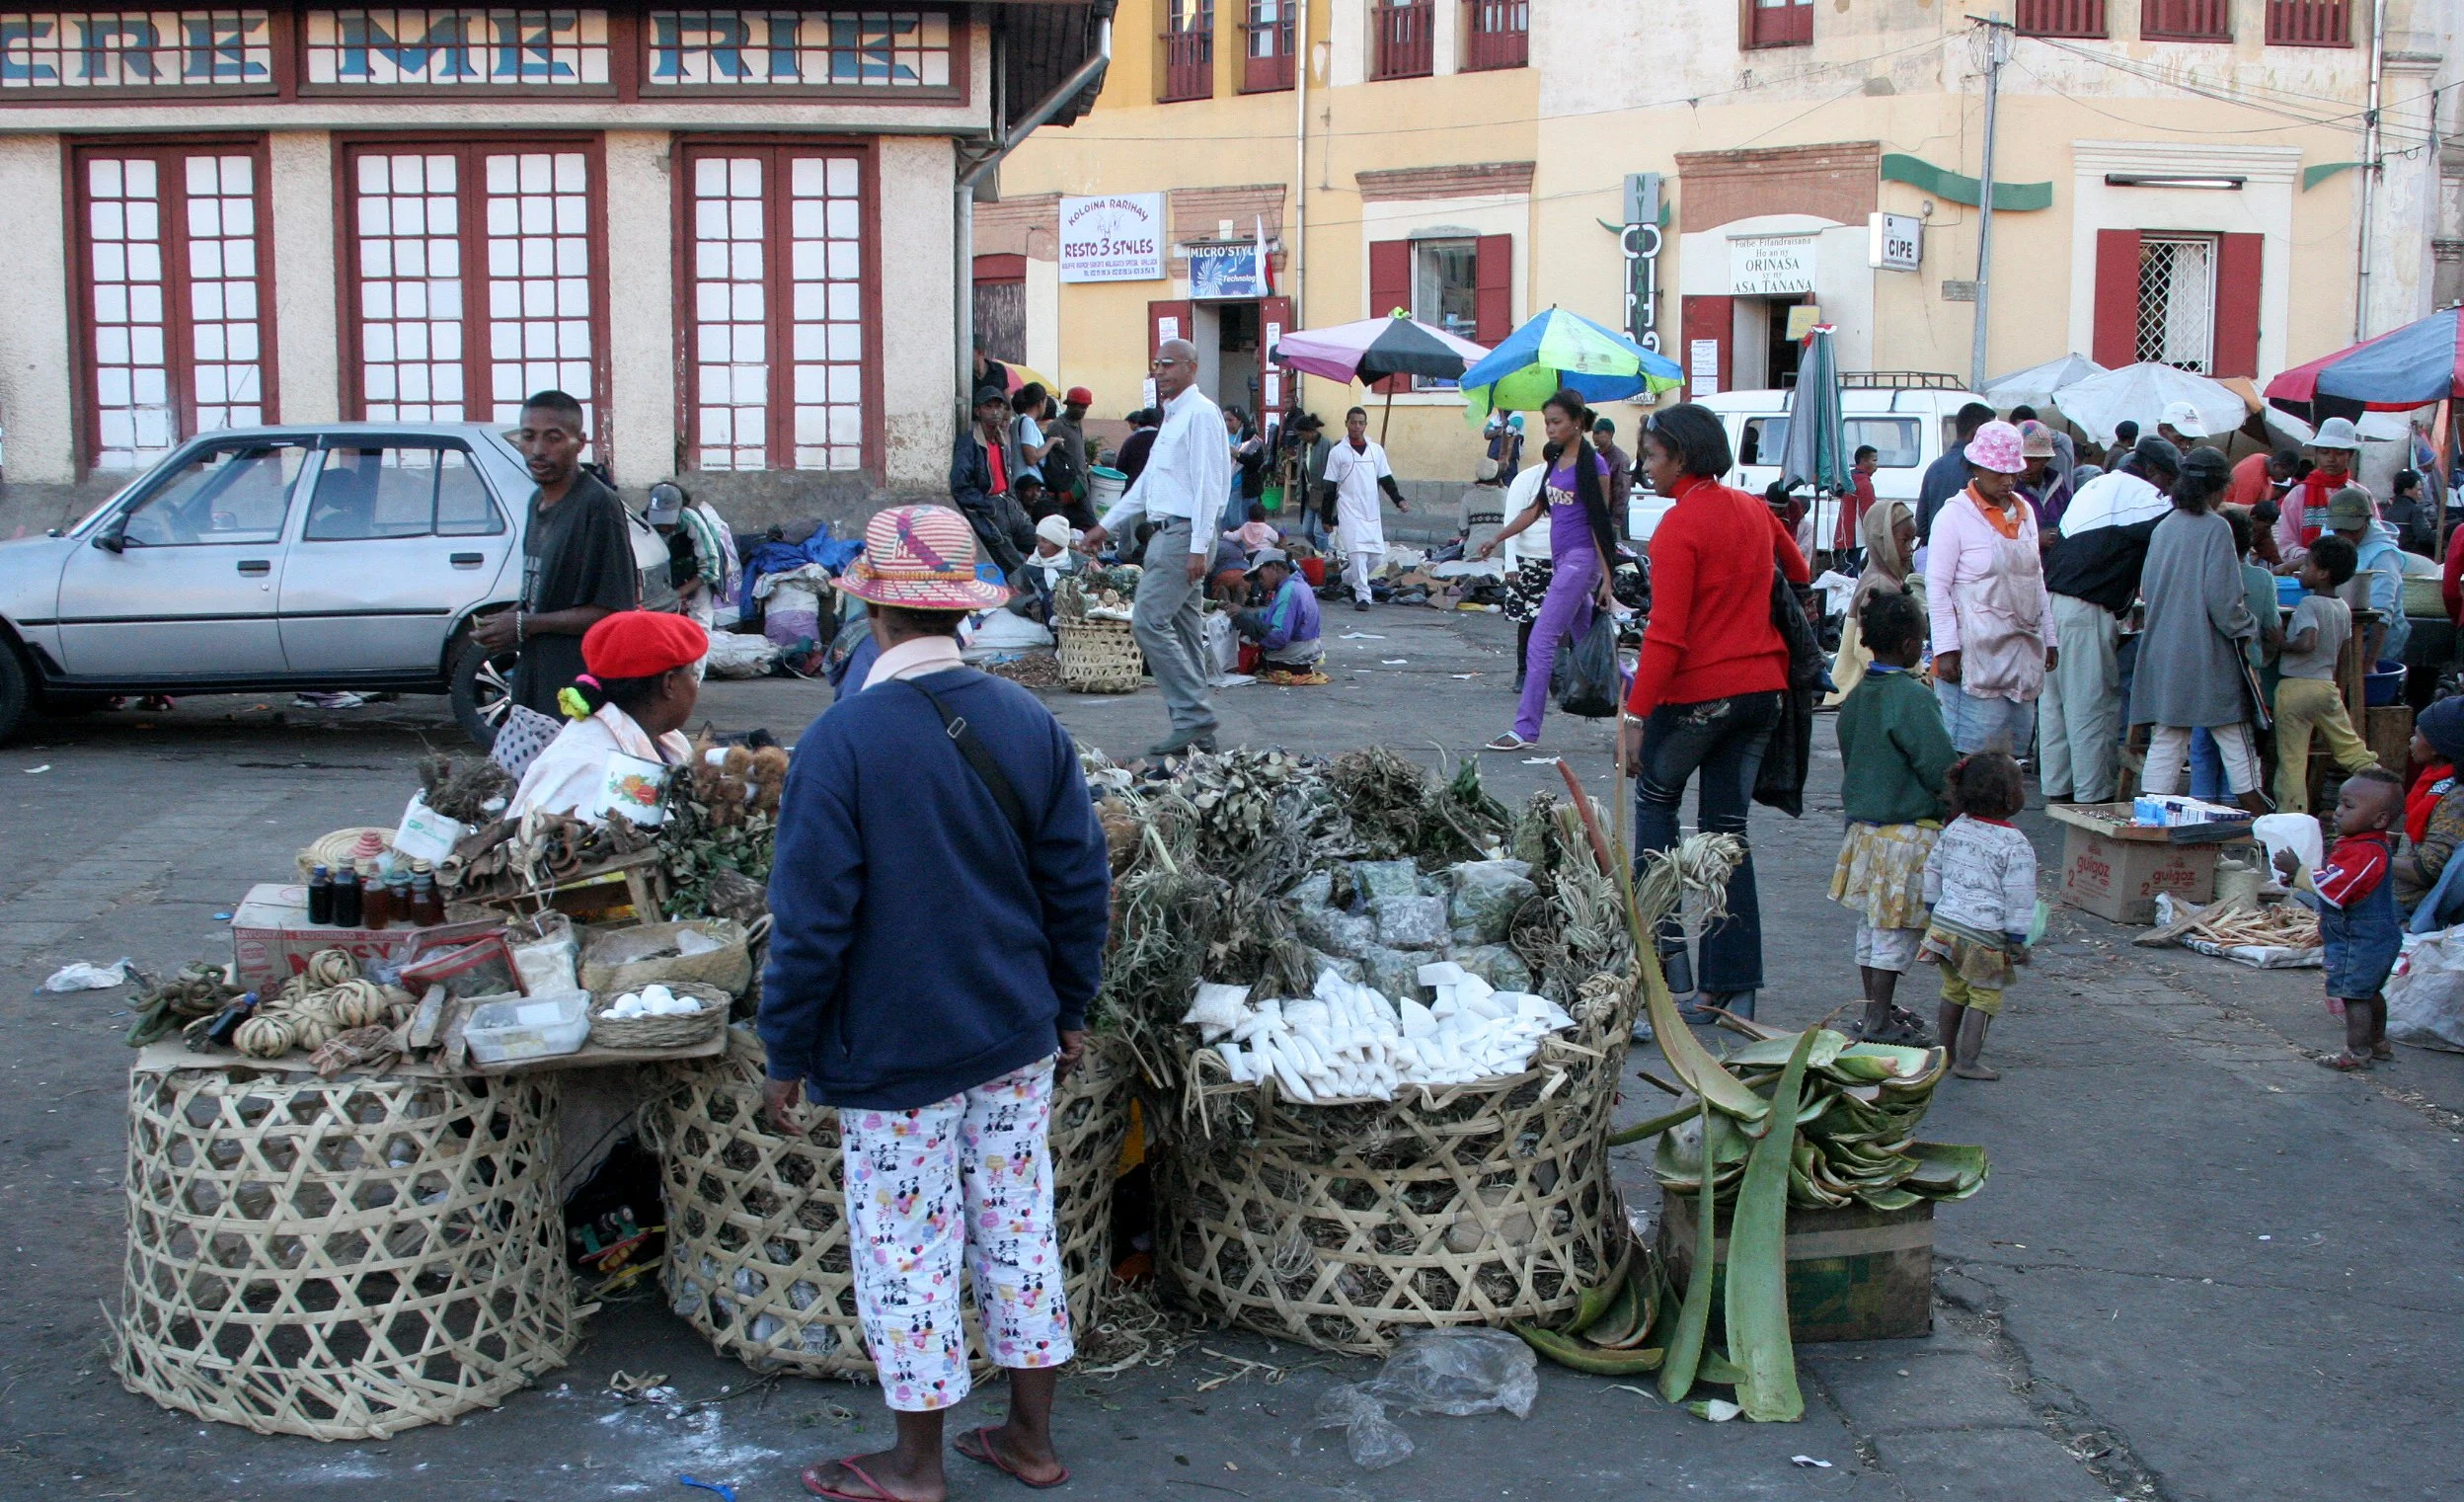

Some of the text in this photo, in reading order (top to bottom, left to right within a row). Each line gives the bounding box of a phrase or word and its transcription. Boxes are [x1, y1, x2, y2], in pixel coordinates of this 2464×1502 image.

[1068, 198, 1148, 226] KOLOINA RARIHAY
[1064, 237, 1154, 258] RESTO 3 STYLES
[1191, 246, 1258, 260] MICRO'STYL
[1888, 239, 1912, 258] CIPE
[1745, 257, 1800, 273] ORINASA
[1733, 278, 1812, 293] ASA TANANA
[2068, 869, 2075, 887] 2
[2140, 882, 2150, 897] 2
